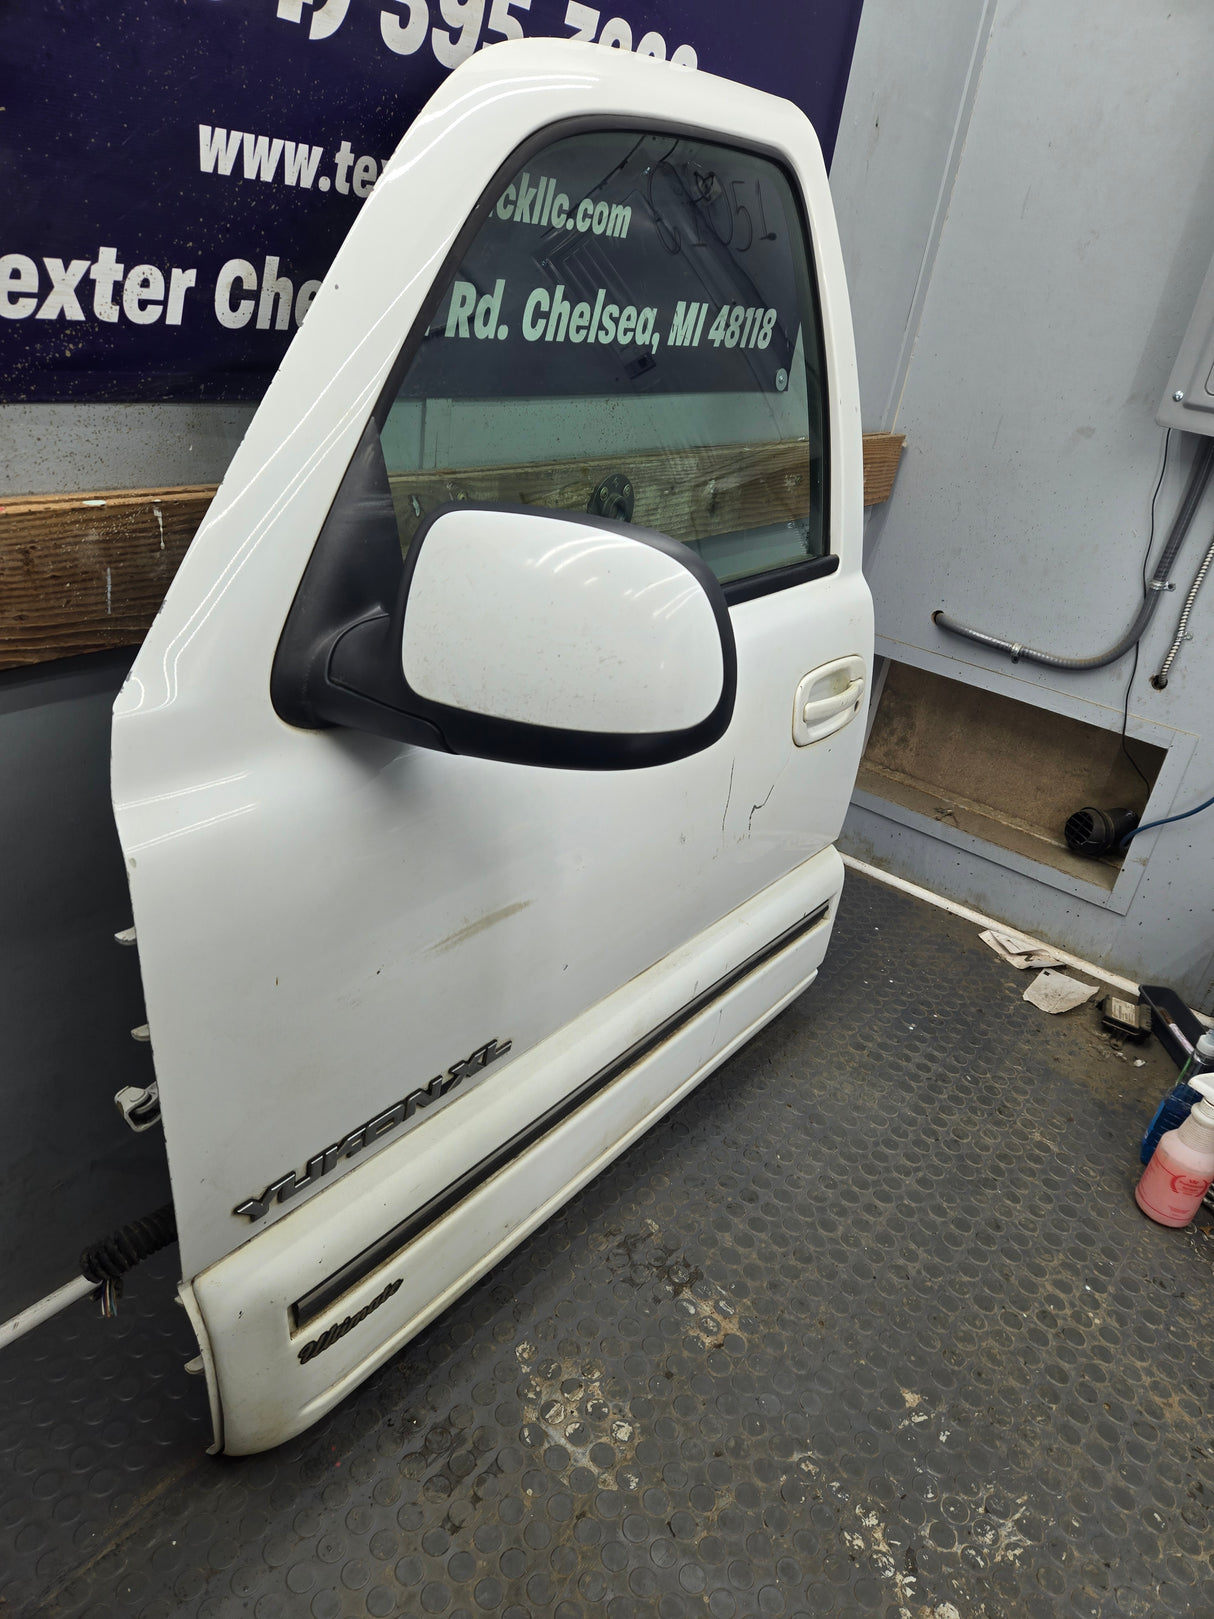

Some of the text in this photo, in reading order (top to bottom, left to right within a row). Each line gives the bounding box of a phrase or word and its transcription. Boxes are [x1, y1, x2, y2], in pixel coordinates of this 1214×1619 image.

[199, 124, 632, 238] www.te ckllc.com
[444, 279, 508, 340] Rd.
[522, 284, 660, 354] Chelsea,
[667, 301, 708, 347] MI
[707, 305, 777, 349] 48118
